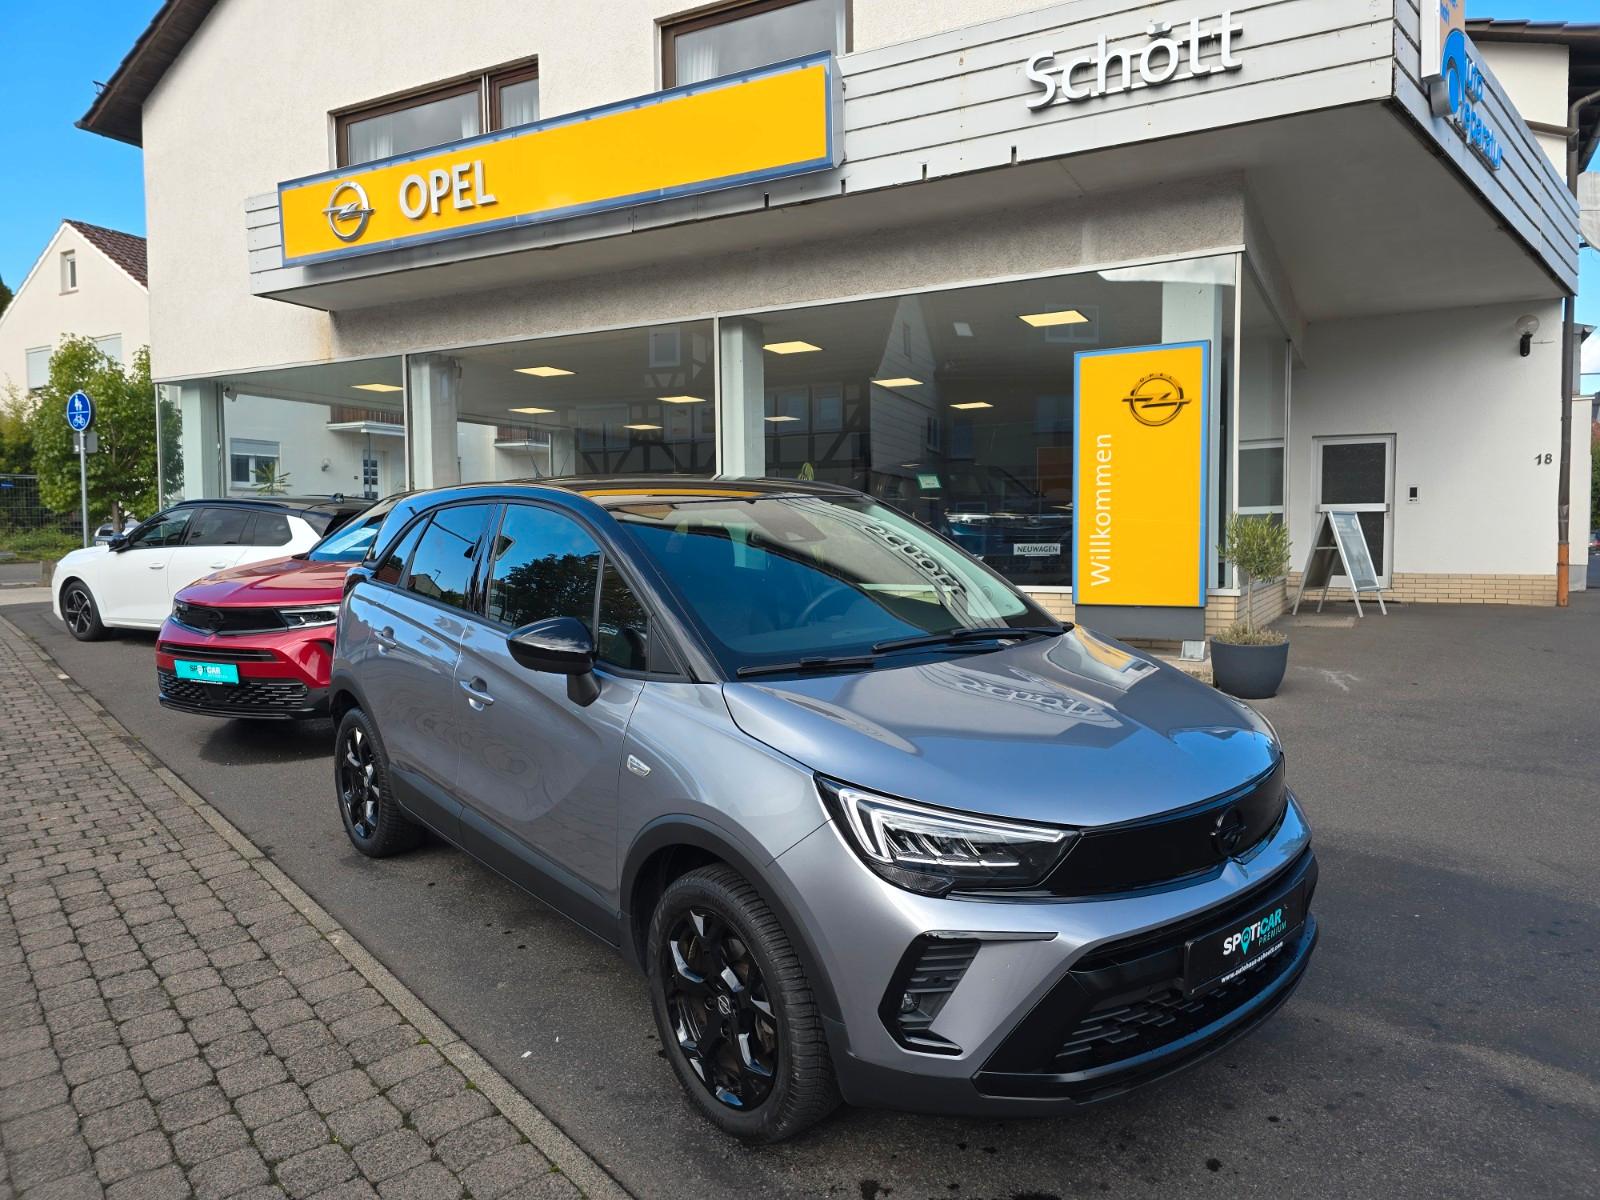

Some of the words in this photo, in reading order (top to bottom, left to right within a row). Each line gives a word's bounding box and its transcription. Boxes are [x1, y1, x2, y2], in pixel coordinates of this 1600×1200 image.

[1025, 9, 1244, 112] Schött
[1465, 56, 1484, 101] uto
[399, 160, 497, 219] OPEL
[1534, 453, 1553, 465] 18
[1089, 433, 1112, 586] Willkommen
